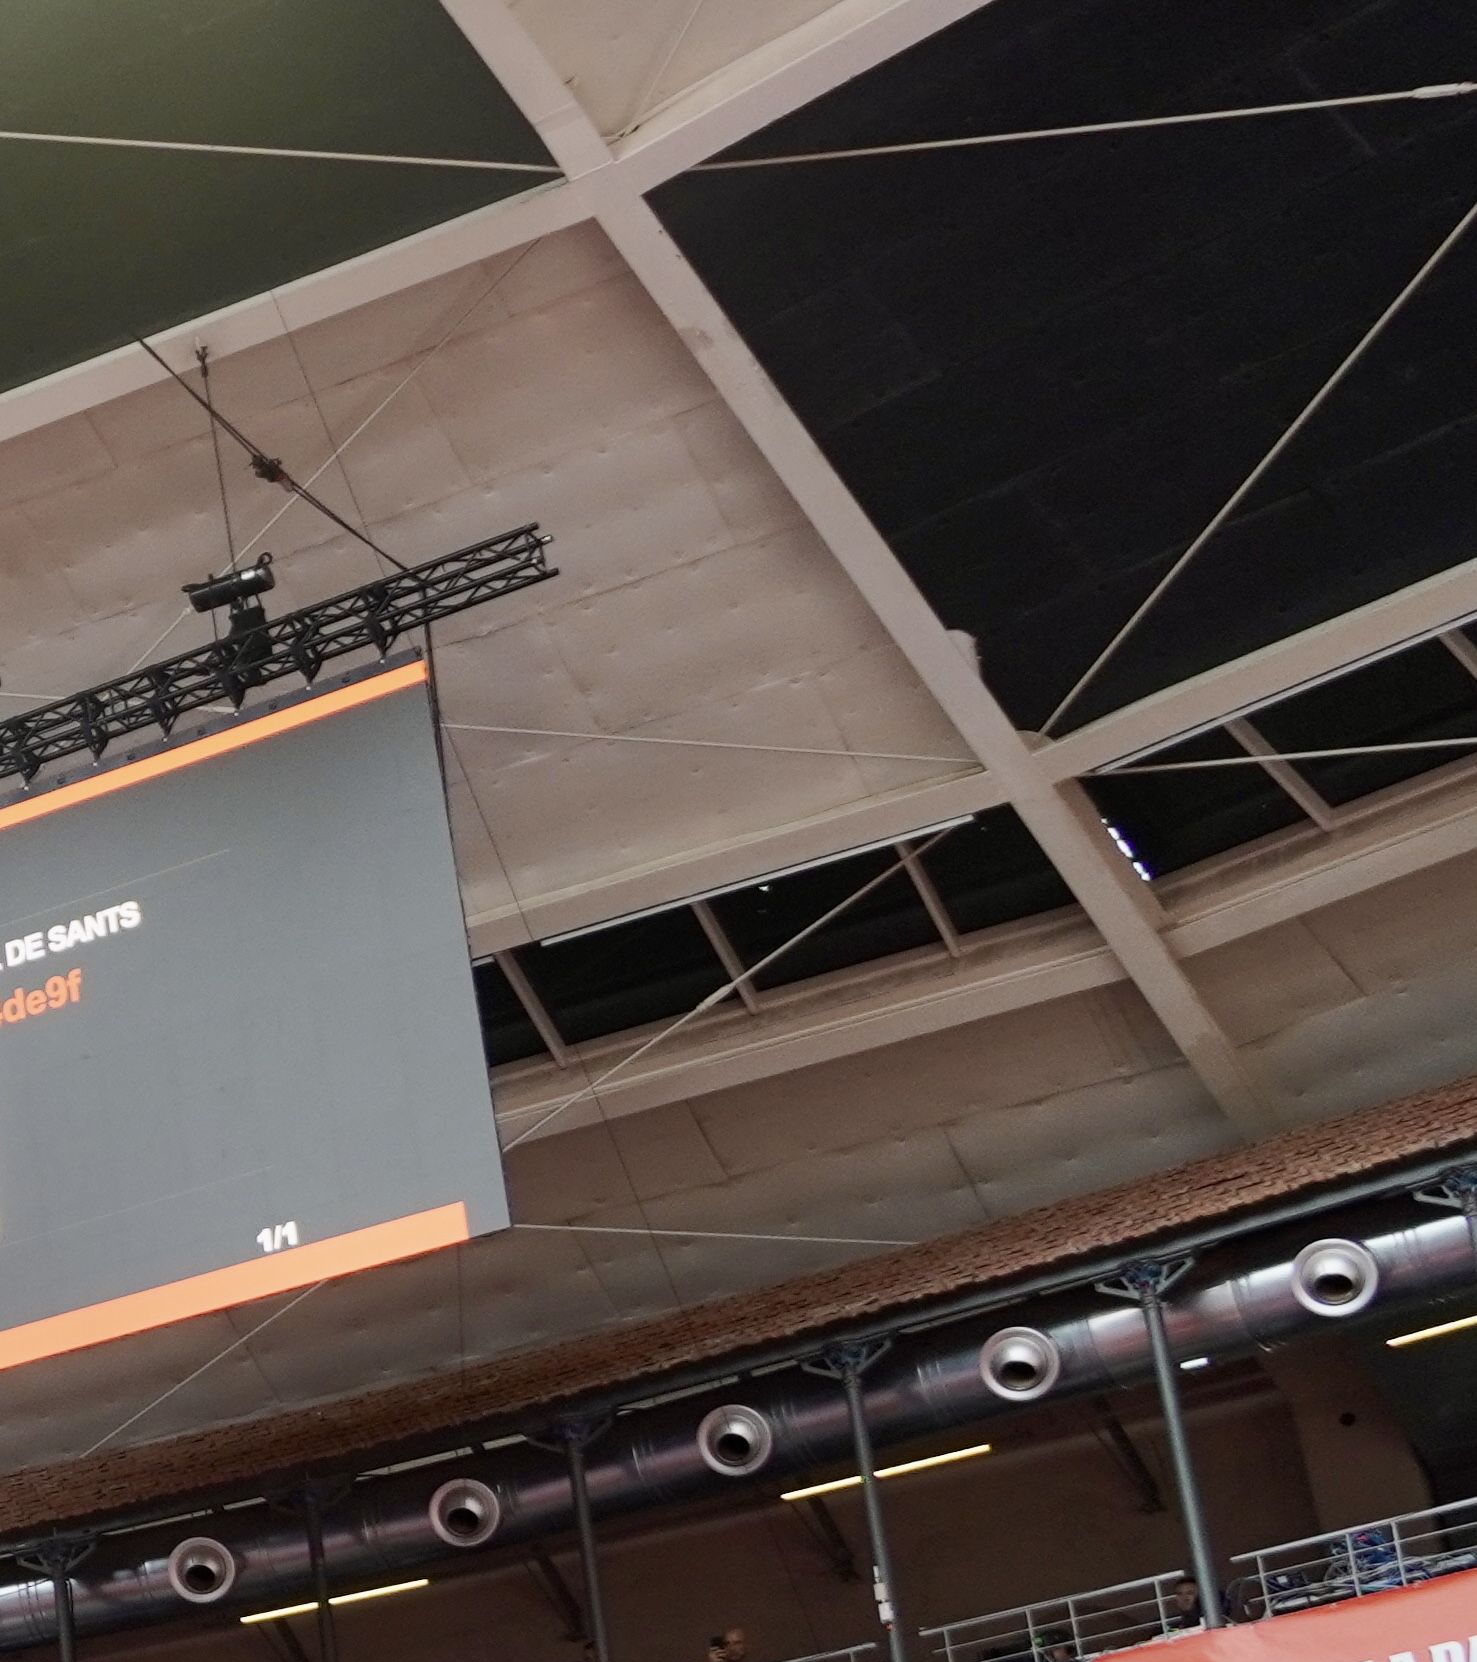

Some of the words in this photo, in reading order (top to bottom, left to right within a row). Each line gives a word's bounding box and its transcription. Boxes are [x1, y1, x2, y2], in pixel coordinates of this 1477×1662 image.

[5, 931, 46, 968] DE
[47, 900, 143, 952] SANTS
[255, 1221, 299, 1252] 1/1
